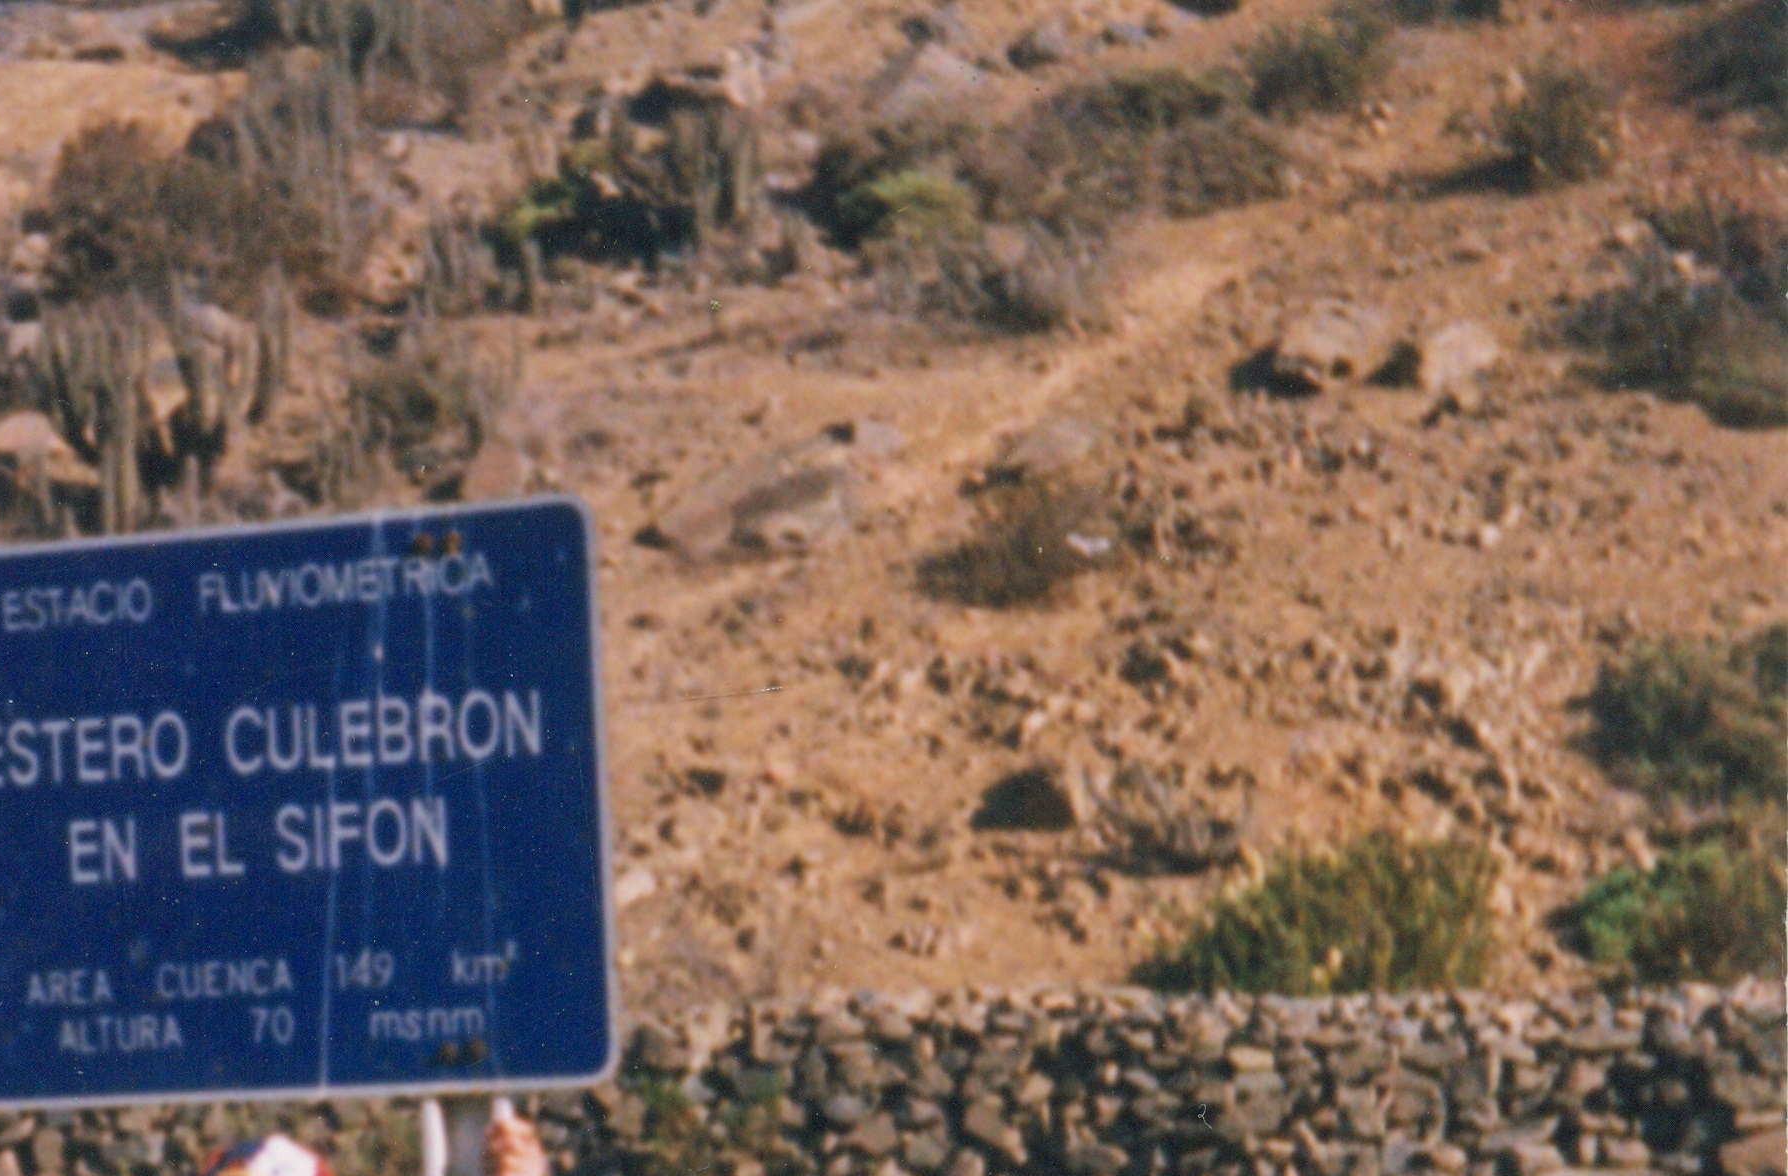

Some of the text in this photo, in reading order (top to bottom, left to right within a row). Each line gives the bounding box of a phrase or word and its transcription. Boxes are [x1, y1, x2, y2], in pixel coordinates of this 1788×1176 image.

[198, 551, 493, 613] FLUVIOMETRICA
[225, 689, 543, 774] CULEBRON
[69, 798, 449, 884] EN EL SIFON
[26, 969, 113, 1006] AREA
[156, 958, 294, 1001] CUENCA
[334, 947, 395, 991] 149
[58, 1005, 486, 1055] ALTURA 70 msnm
